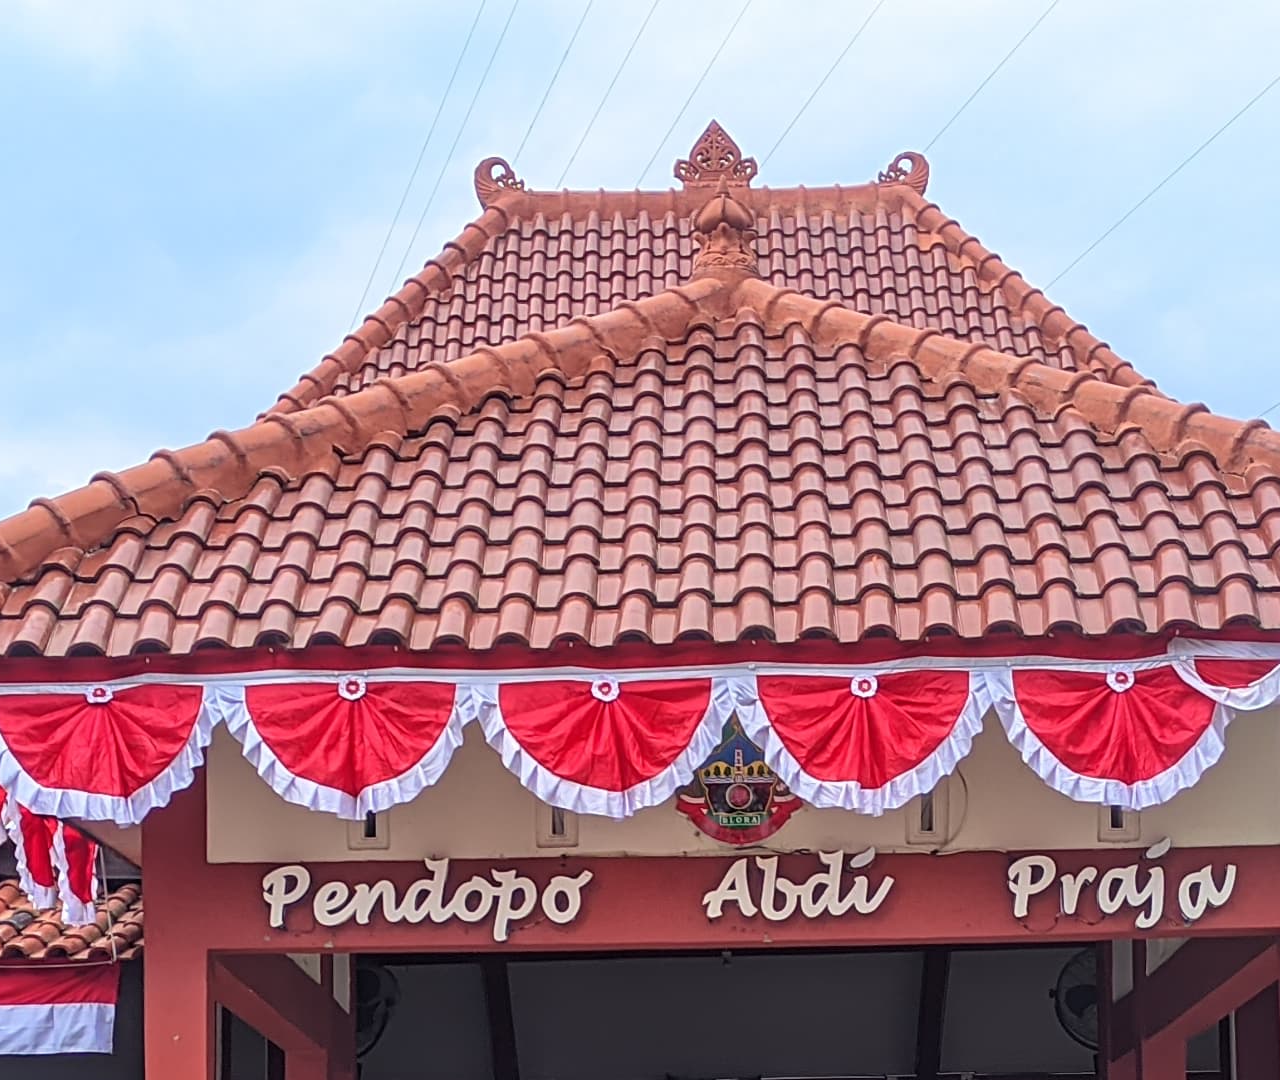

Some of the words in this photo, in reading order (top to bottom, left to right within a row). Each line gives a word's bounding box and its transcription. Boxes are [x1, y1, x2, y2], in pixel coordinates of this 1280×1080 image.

[722, 816, 758, 825] BLORA
[263, 858, 592, 942] Pendopo
[703, 847, 894, 921] Abdi
[1008, 838, 1237, 929] Praja
